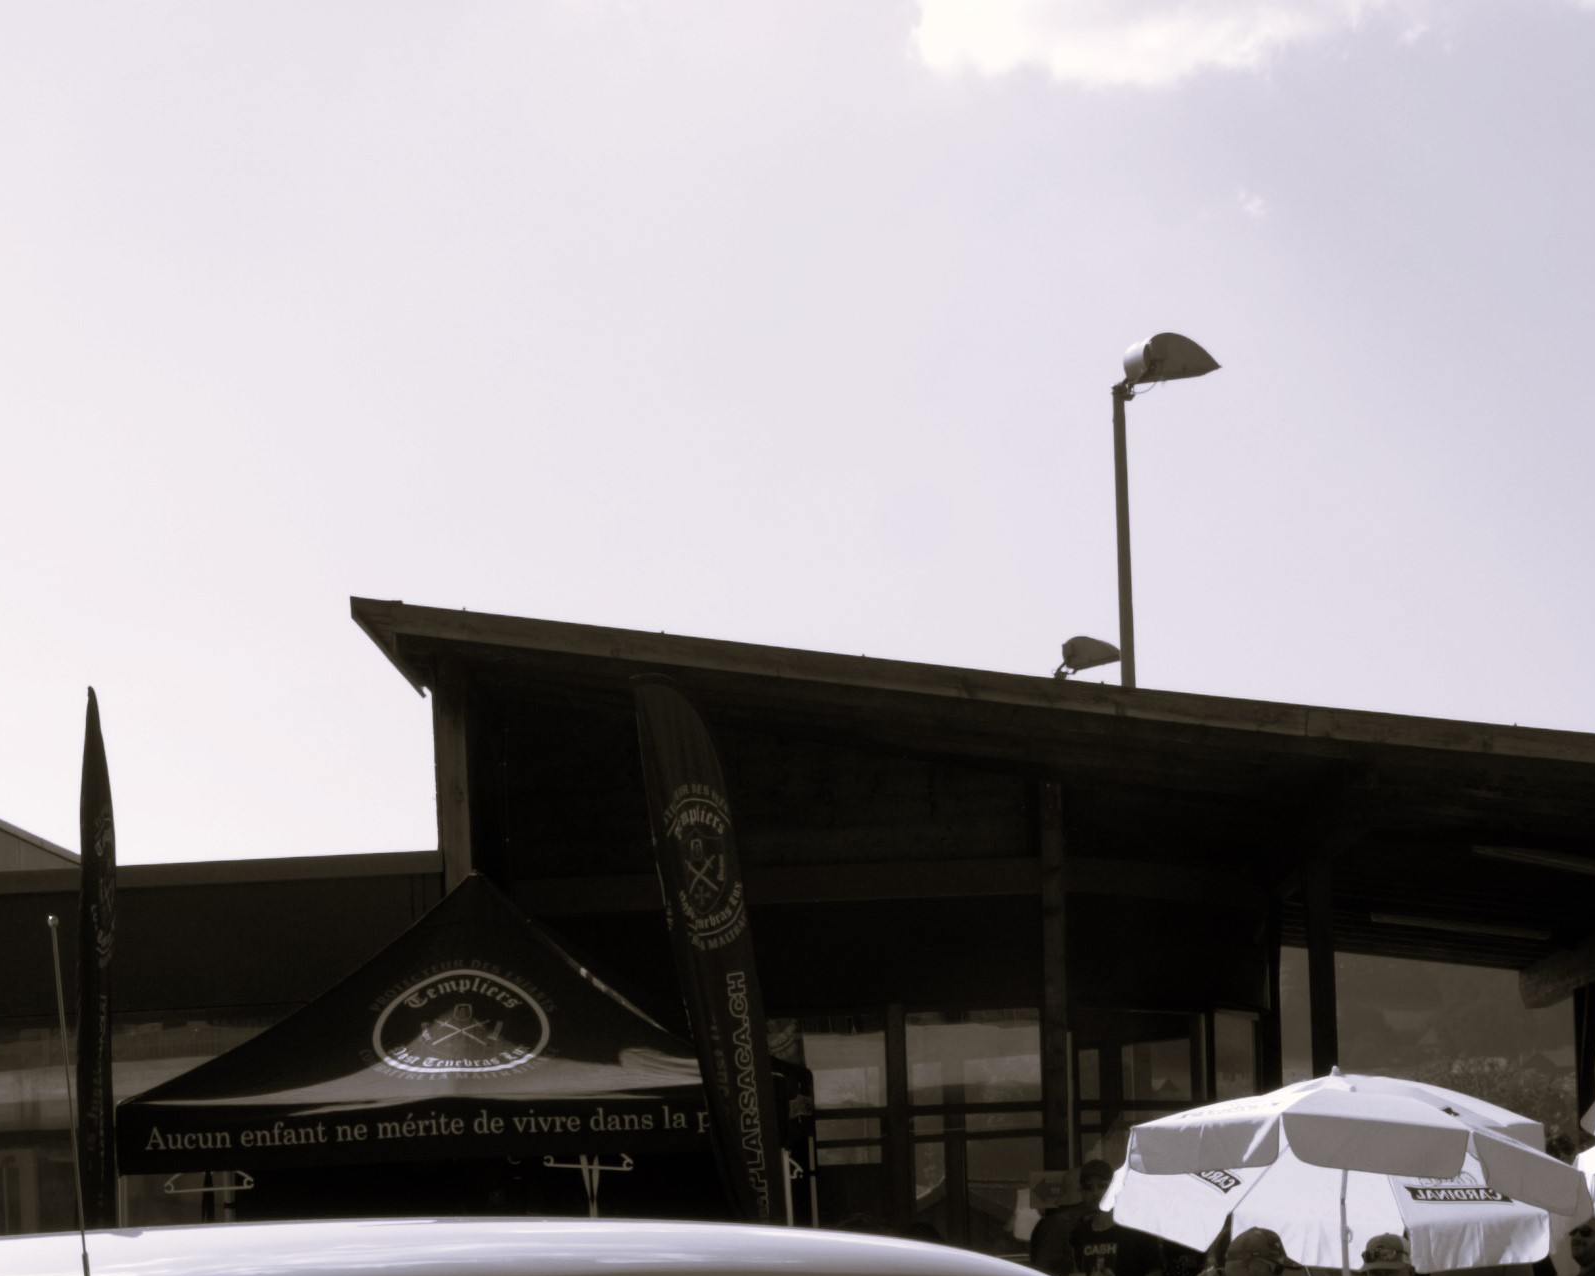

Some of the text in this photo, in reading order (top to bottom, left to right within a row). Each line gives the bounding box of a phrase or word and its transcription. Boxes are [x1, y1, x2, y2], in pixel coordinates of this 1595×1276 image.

[404, 976, 523, 1009] Templiers
[145, 1126, 233, 1151] Aucun
[240, 1120, 328, 1148] enfant
[335, 1122, 368, 1143] ne
[376, 1111, 465, 1140] mérite
[473, 1109, 505, 1135] de
[512, 1108, 582, 1134] vivre
[589, 1106, 654, 1132] dans
[661, 1104, 688, 1131] la
[1084, 1242, 1118, 1256] CASH
